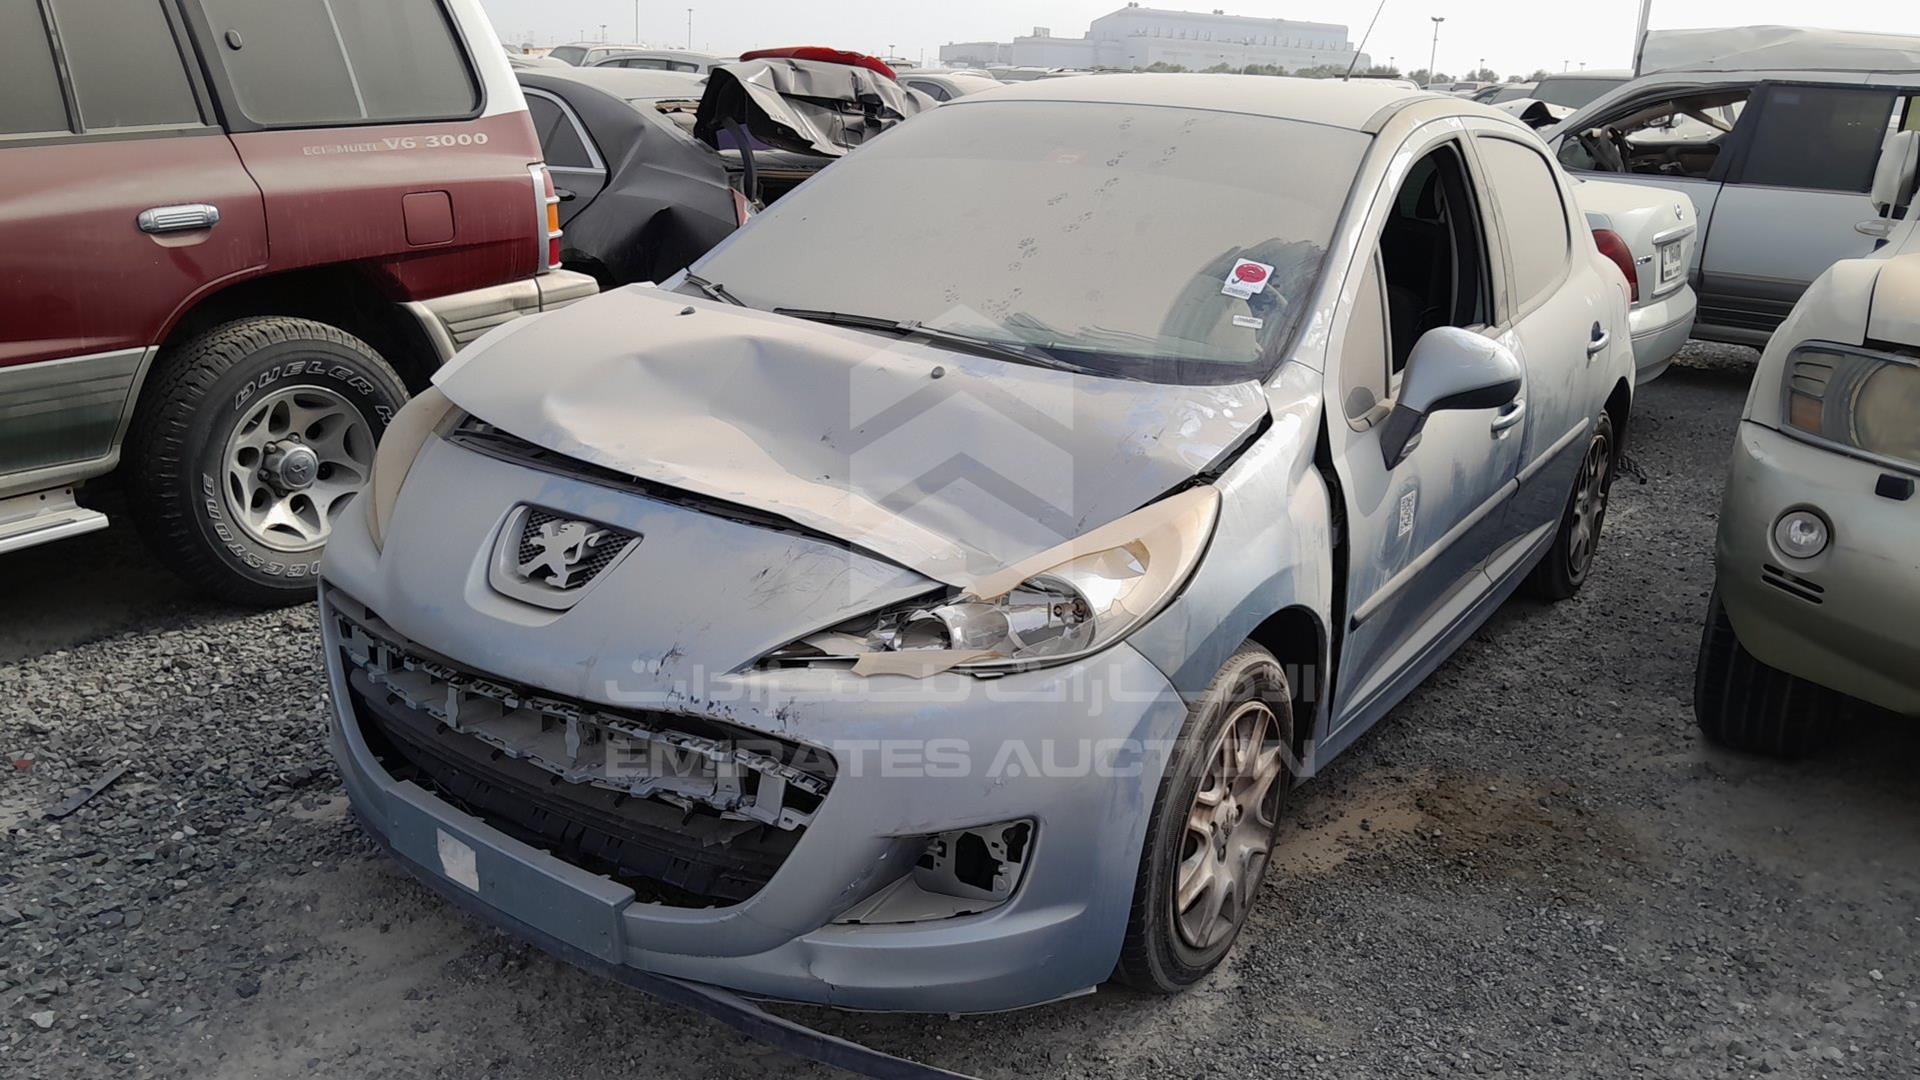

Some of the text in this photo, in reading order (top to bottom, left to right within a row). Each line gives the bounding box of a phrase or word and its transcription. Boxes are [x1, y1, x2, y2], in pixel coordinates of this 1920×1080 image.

[382, 137, 416, 150] V6
[425, 133, 488, 148] 3000
[235, 361, 375, 410] DUELER
